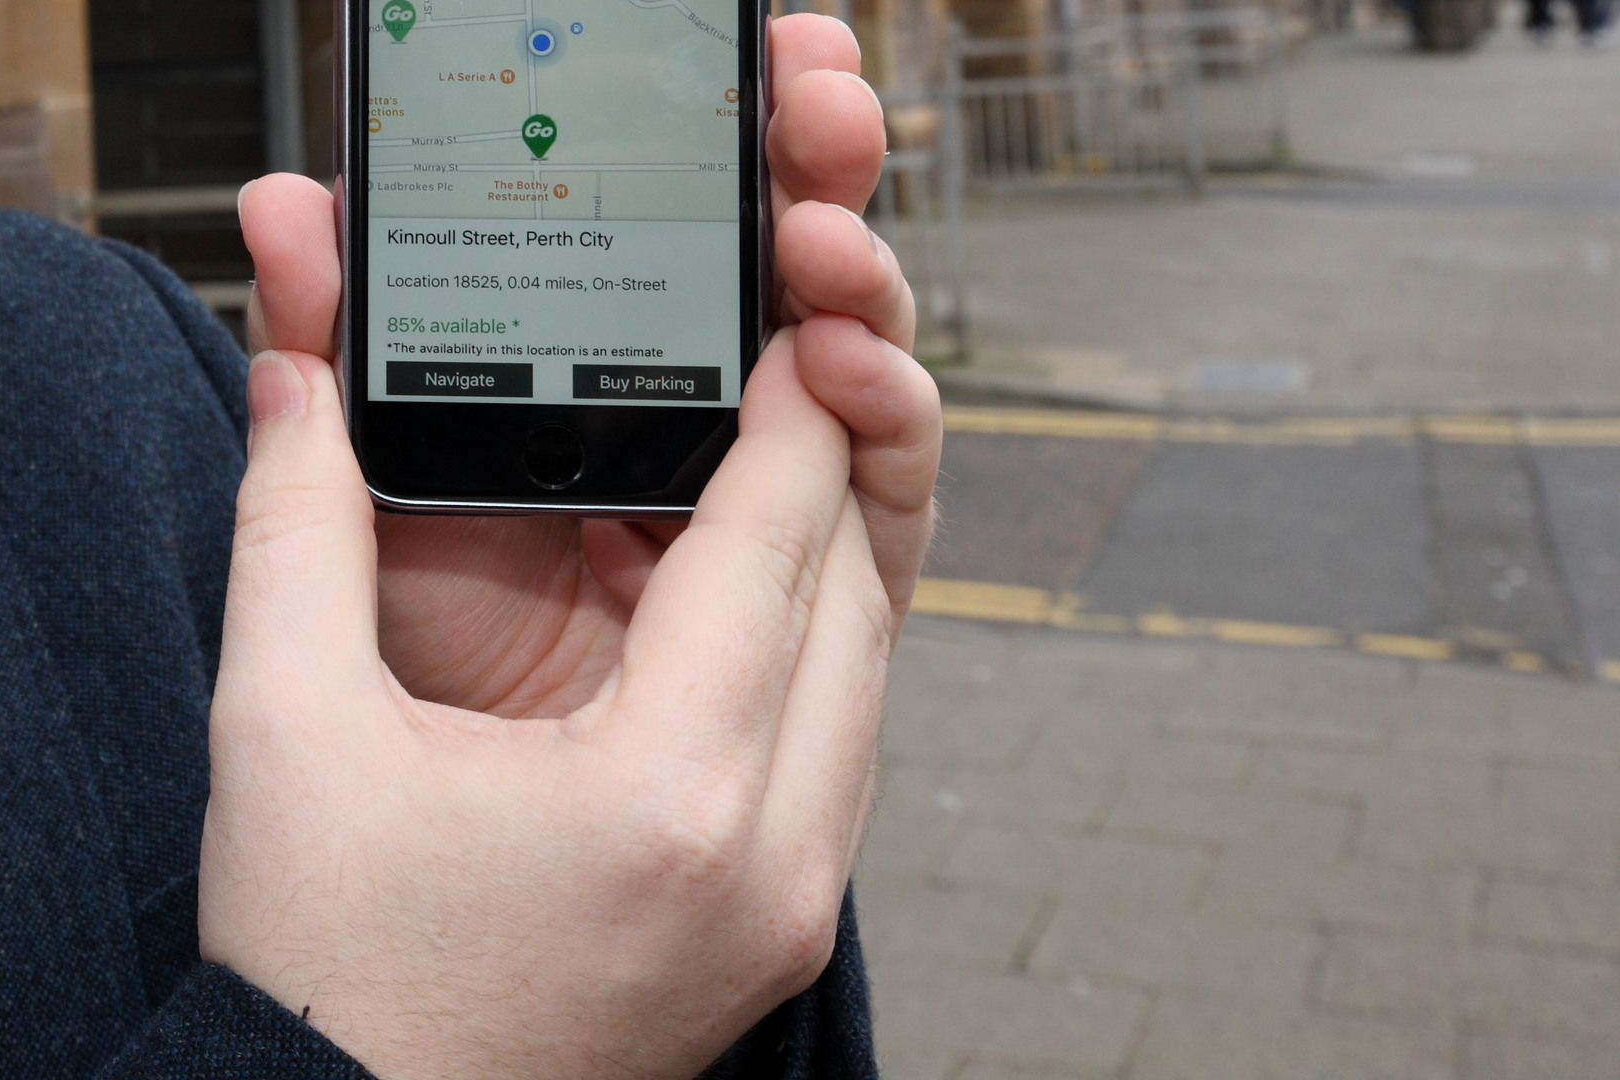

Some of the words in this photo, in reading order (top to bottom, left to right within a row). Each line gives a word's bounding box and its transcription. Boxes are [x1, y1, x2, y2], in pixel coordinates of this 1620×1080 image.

[385, 5, 413, 21] Go
[424, 5, 432, 15] St
[688, 12, 733, 45] Blackfriars
[438, 72, 445, 81] L
[447, 72, 455, 81] A
[457, 72, 486, 82] Serie
[488, 72, 496, 82] A
[369, 106, 405, 117] ctions
[715, 107, 739, 117] Kisa
[525, 121, 553, 138] Go
[411, 137, 445, 146] Murray
[446, 135, 458, 144] St
[413, 163, 447, 173] Murray
[448, 163, 459, 172] St
[699, 162, 716, 171] Mill
[717, 163, 729, 172] St
[377, 182, 434, 191] Ladbrokes
[437, 182, 454, 192] Plc
[494, 180, 513, 190] The
[516, 180, 549, 192] Bothy
[487, 191, 549, 201] Restaurant
[388, 229, 456, 245] Kinnoull
[462, 230, 520, 249] Street,
[526, 231, 573, 247] Perth
[579, 231, 614, 251] City
[387, 275, 449, 288] Location
[453, 275, 503, 291] 18525,
[507, 276, 540, 289] 0.04
[545, 276, 588, 292] miles,
[593, 277, 667, 292] On-Street
[387, 317, 425, 333] 85%
[430, 318, 506, 334] available
[419, 343, 482, 357] availability
[486, 344, 497, 355] in
[501, 344, 523, 355] this
[527, 345, 575, 356] location
[578, 345, 589, 356] is
[592, 348, 607, 357] an
[611, 346, 664, 358] estimate
[425, 372, 495, 390] Navigate
[600, 375, 630, 393] Buy
[635, 376, 695, 394] Parking
